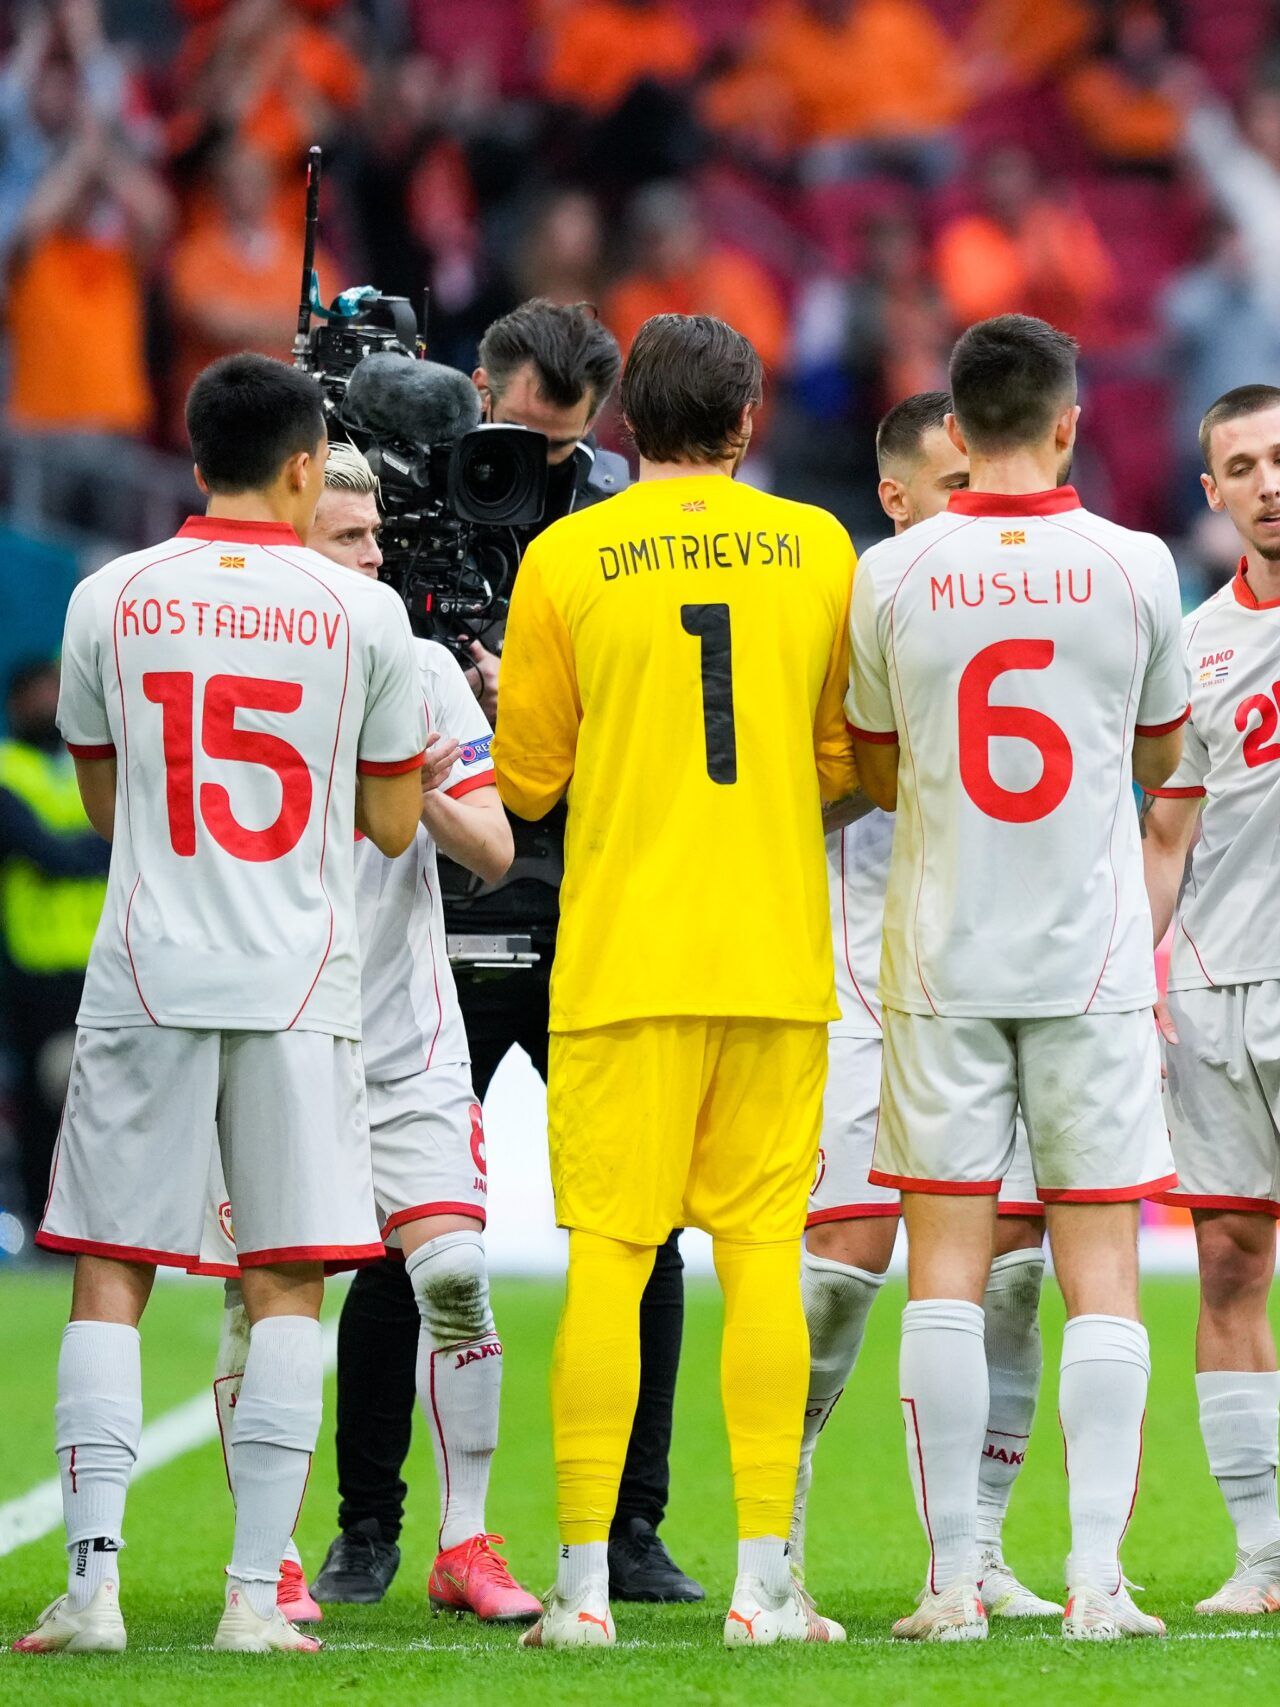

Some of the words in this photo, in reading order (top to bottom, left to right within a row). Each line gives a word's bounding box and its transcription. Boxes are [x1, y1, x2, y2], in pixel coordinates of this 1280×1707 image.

[598, 531, 802, 581] DIMITRIEVSKI
[930, 568, 1093, 612] MUSLIU
[122, 598, 341, 650] KOSTADINOV
[1199, 649, 1234, 669] JAKO
[680, 602, 737, 785] 1
[957, 638, 1074, 824] 6
[142, 671, 314, 863] 15
[454, 1343, 503, 1371] JAKO
